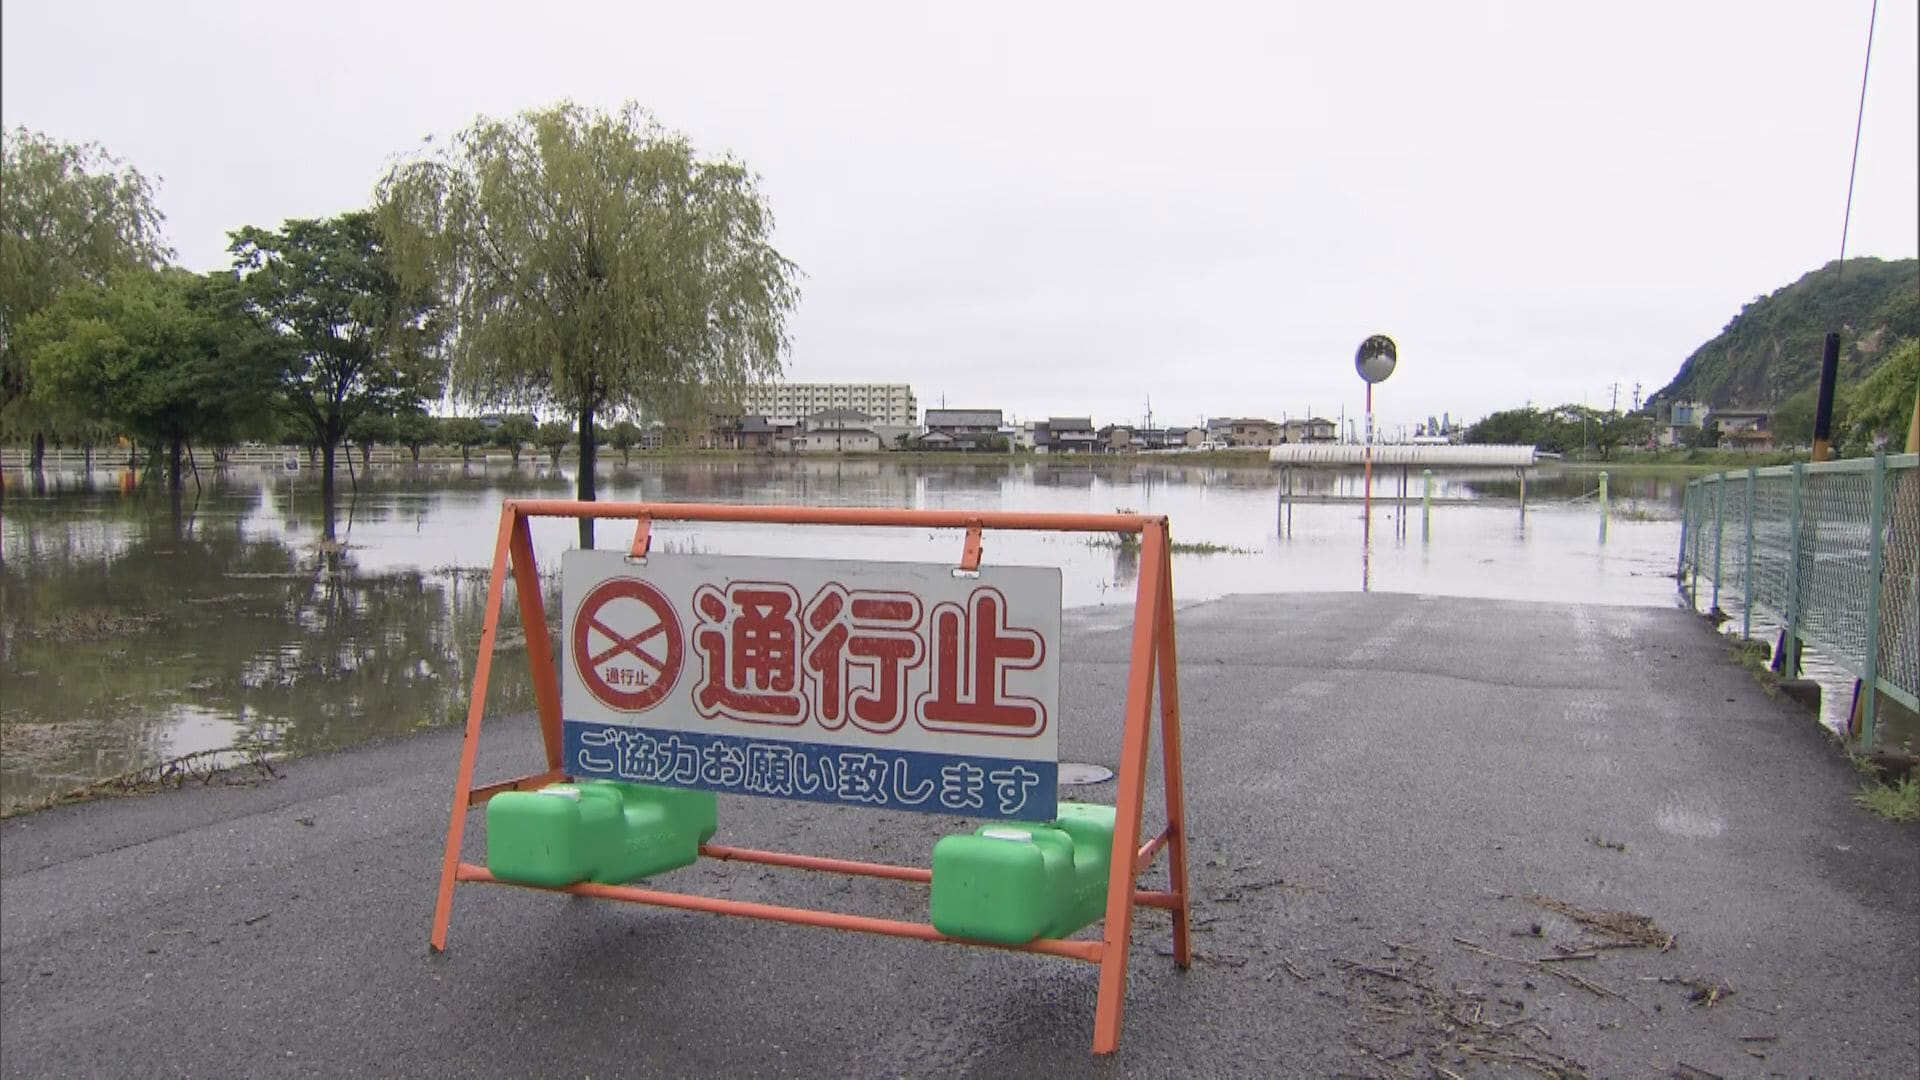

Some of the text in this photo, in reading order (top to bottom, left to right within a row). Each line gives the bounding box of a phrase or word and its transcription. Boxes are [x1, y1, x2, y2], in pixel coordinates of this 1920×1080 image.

[606, 667, 649, 686] 通行止
[692, 581, 1046, 738] 通行止
[578, 728, 1040, 814] ご協力お願い致します
